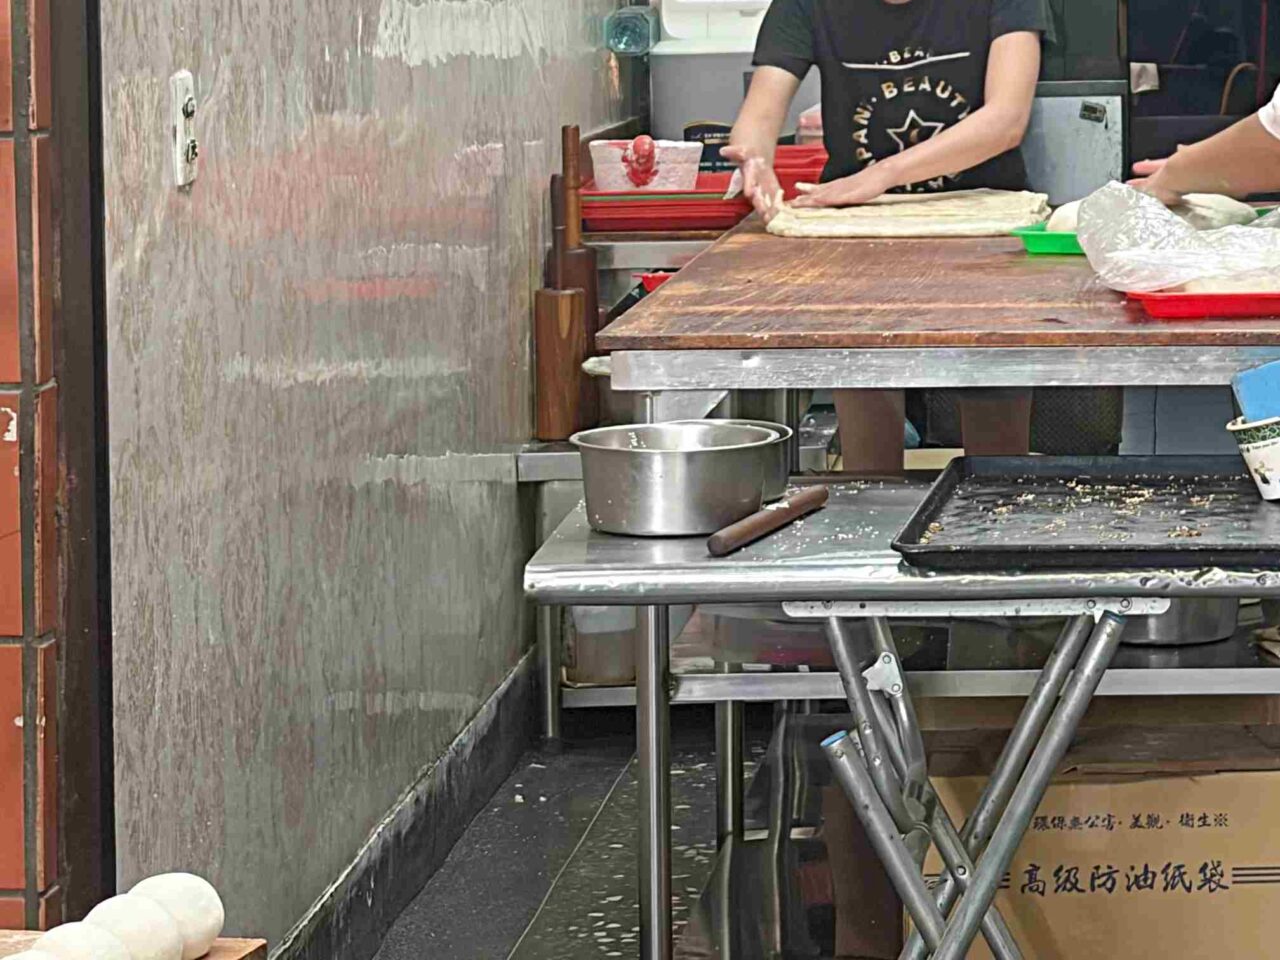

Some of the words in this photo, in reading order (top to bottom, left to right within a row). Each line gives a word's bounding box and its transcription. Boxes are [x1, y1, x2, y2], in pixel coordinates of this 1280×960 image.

[1020, 859, 1230, 897] 高級防油紙袋
